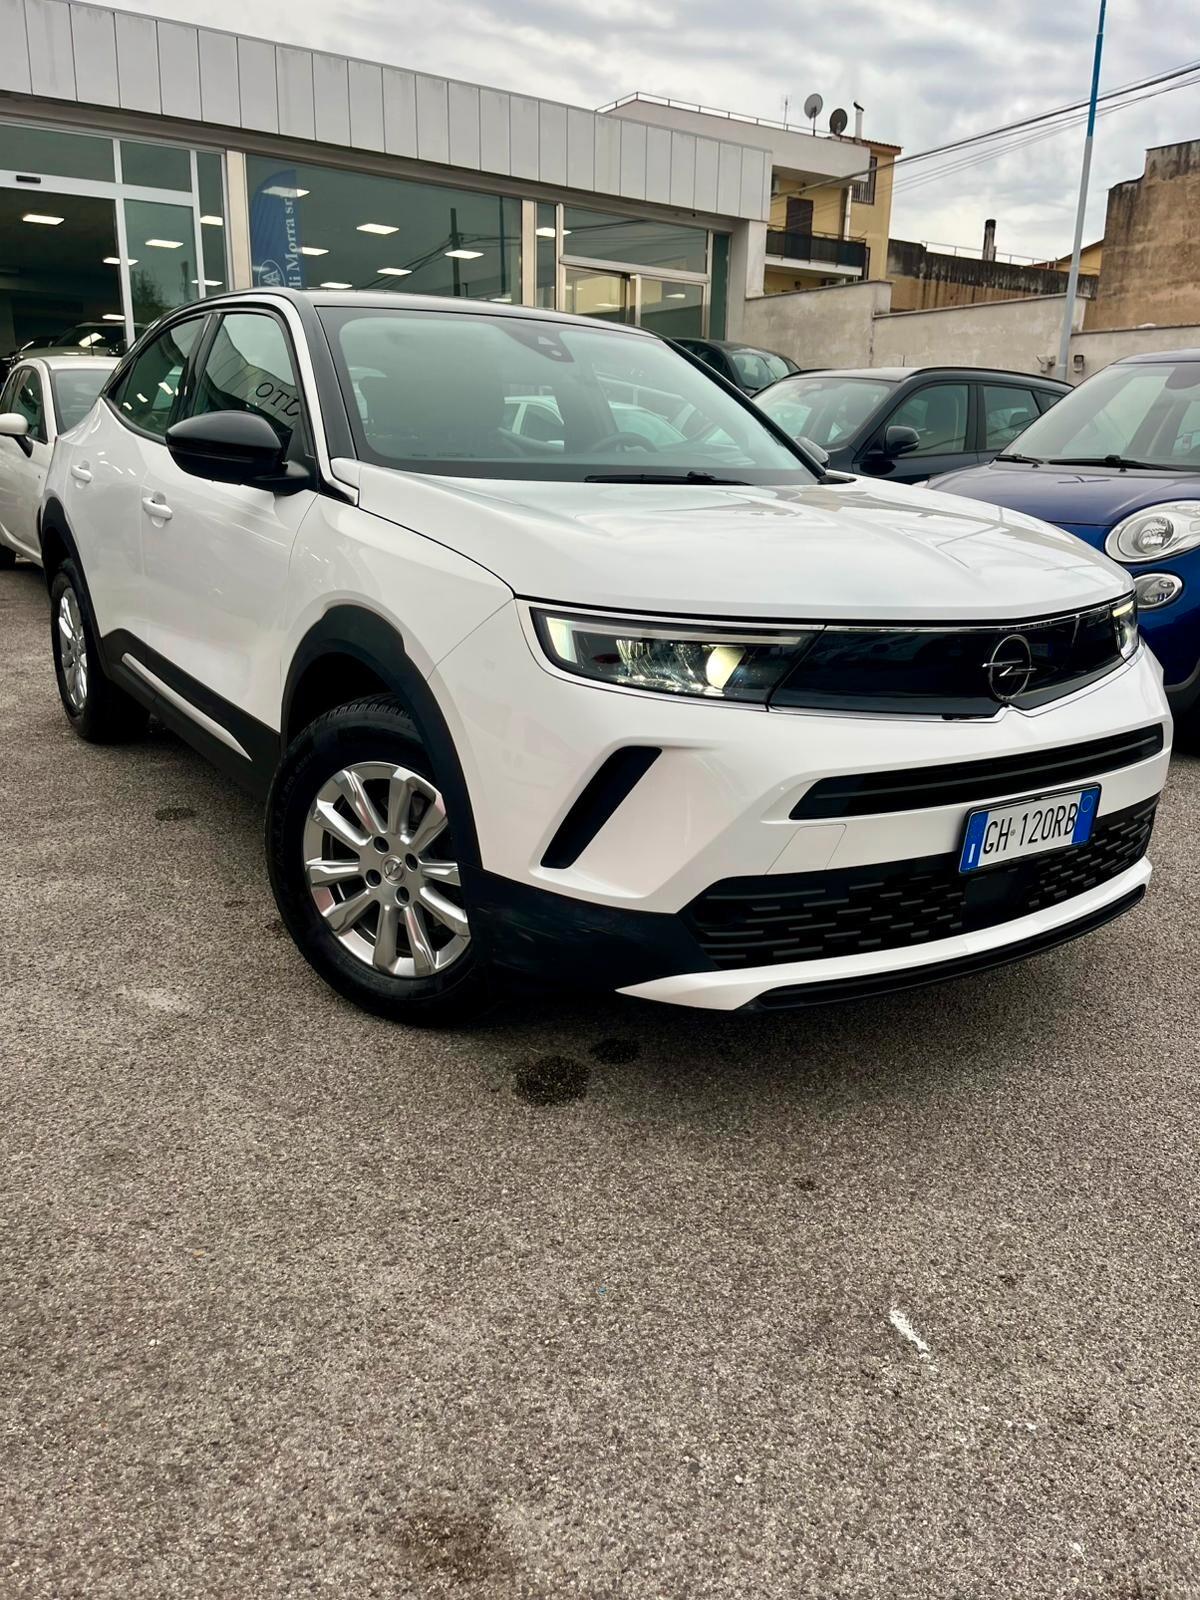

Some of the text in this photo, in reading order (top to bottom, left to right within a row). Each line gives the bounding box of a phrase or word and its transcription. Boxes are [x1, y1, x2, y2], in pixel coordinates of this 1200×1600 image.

[284, 218, 300, 272] Morra
[982, 817, 1013, 855] GH
[1019, 803, 1079, 847] 120RB
